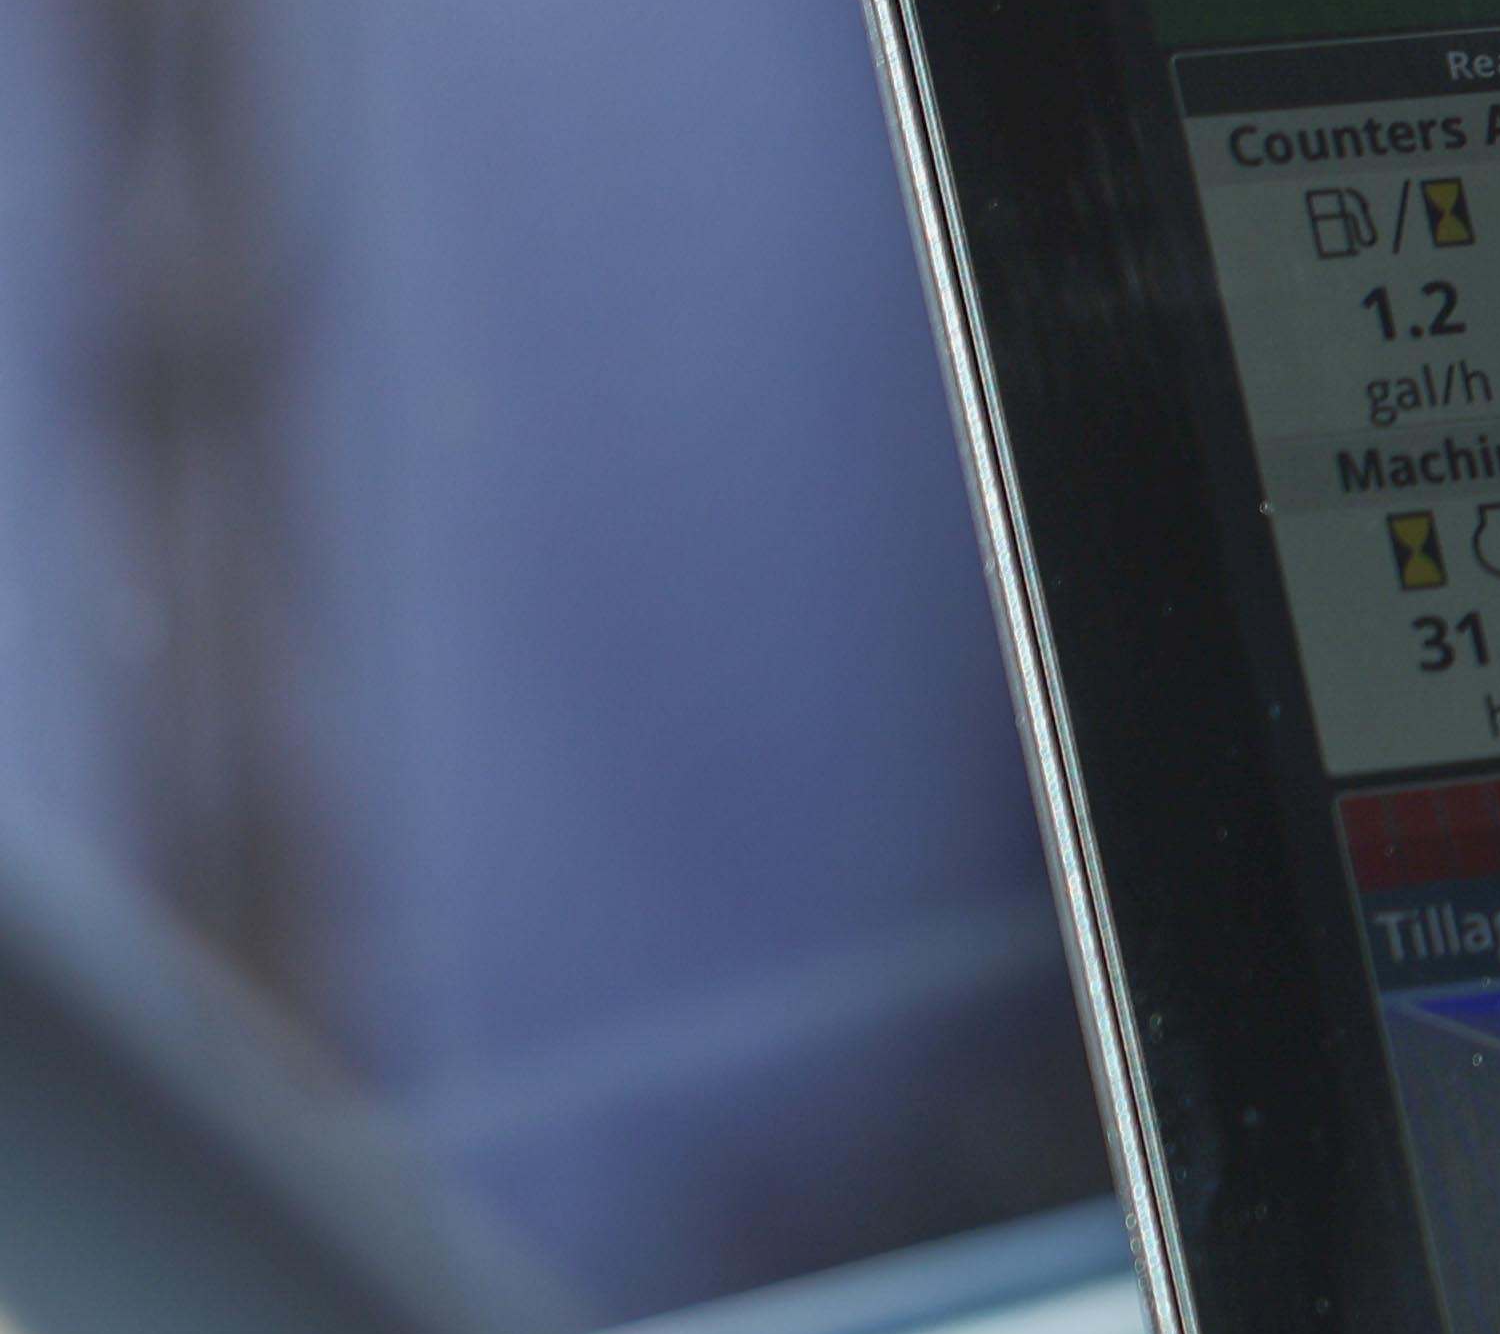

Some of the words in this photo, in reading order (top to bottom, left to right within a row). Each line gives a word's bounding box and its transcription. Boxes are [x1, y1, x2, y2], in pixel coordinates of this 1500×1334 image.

[1227, 109, 1468, 168] Counters
[1360, 279, 1466, 341] 1.2
[1366, 360, 1494, 425] gal/h
